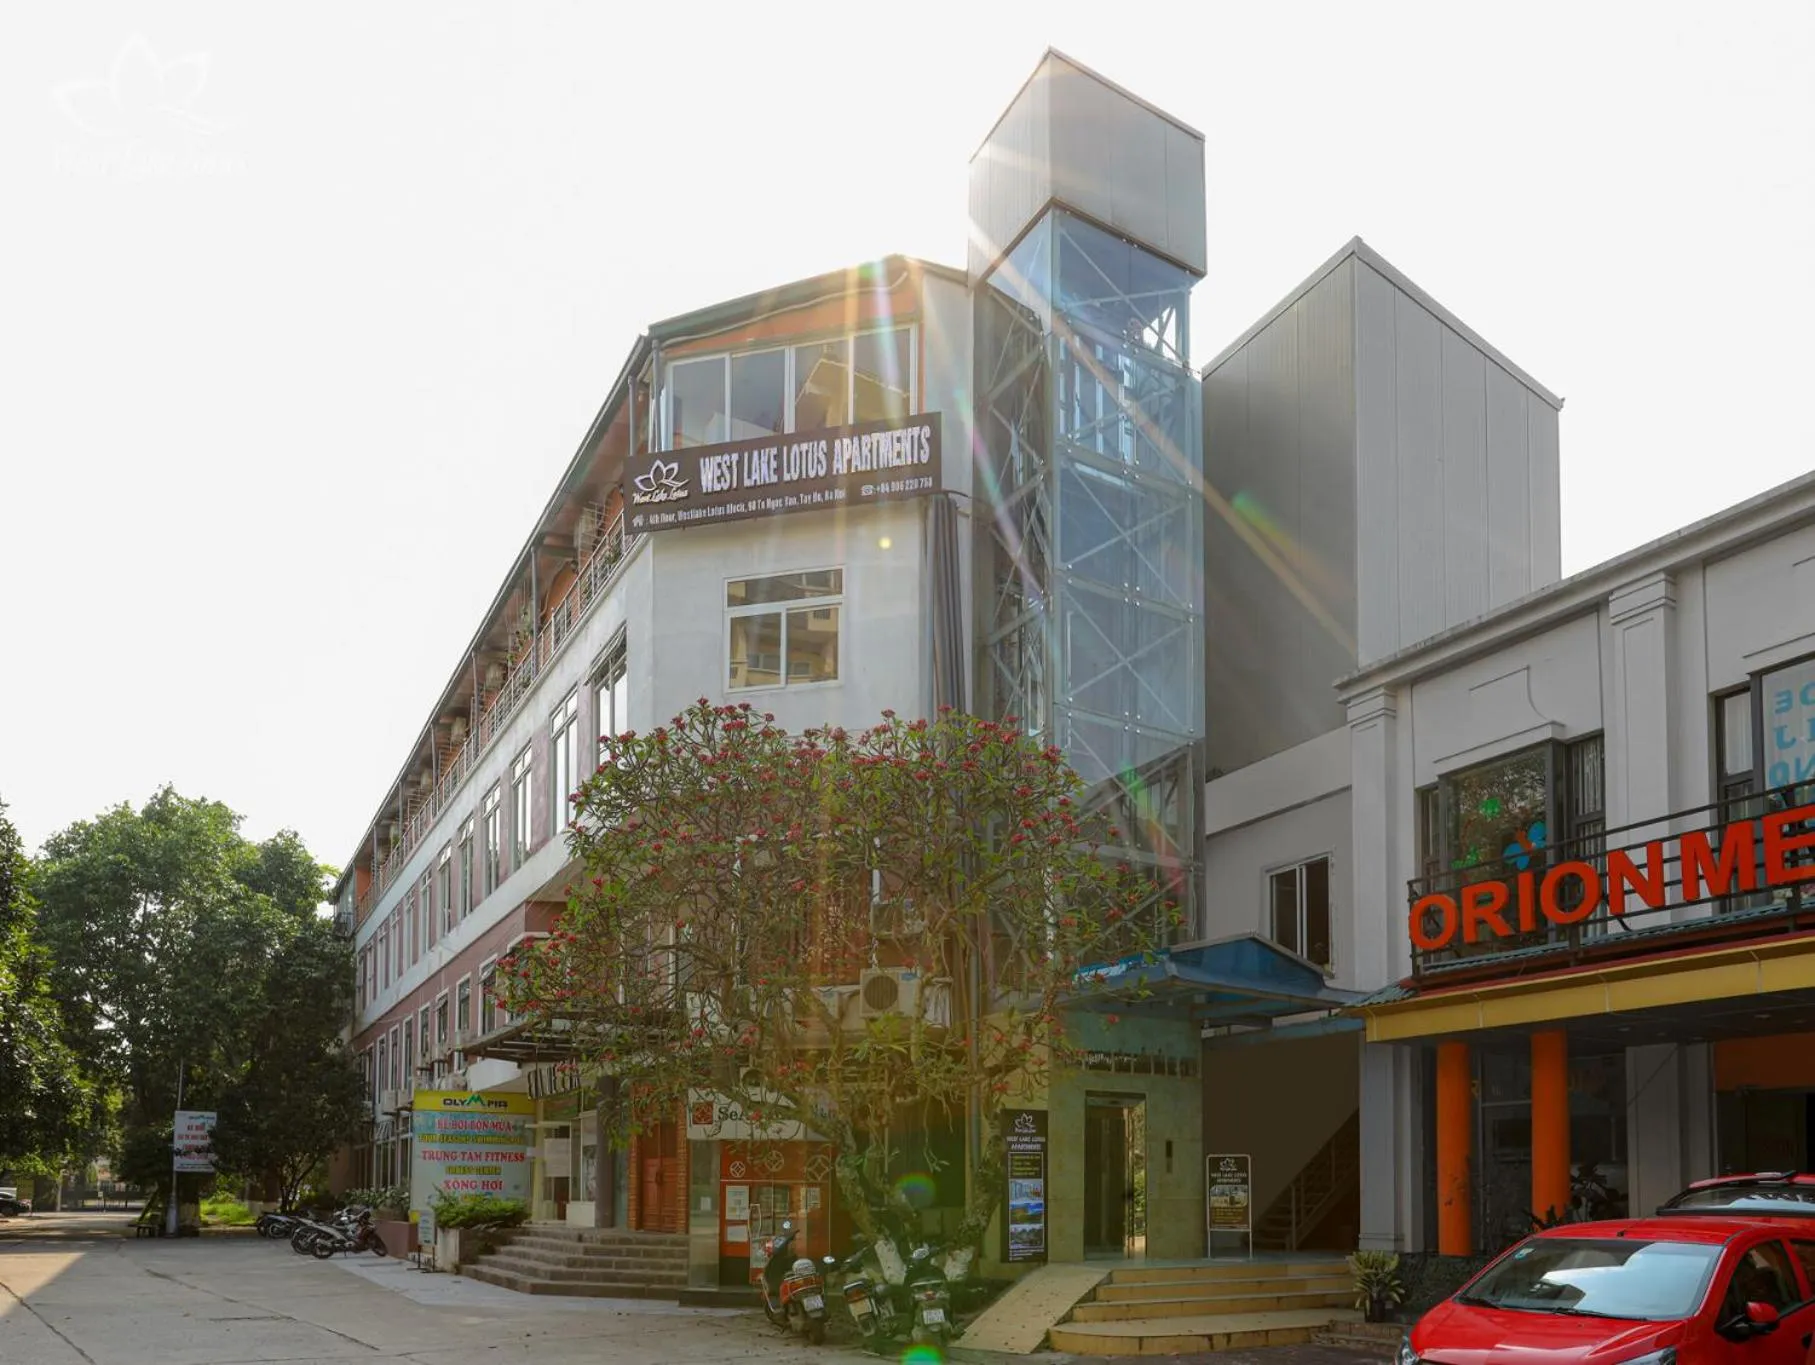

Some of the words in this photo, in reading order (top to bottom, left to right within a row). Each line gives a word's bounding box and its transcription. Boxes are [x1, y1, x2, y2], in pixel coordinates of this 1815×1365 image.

[700, 453, 739, 493] WEST
[743, 446, 778, 487] LAKE
[783, 440, 827, 481] LOTUS
[833, 426, 931, 474] APARTMENTS
[1409, 841, 1666, 951] ORION
